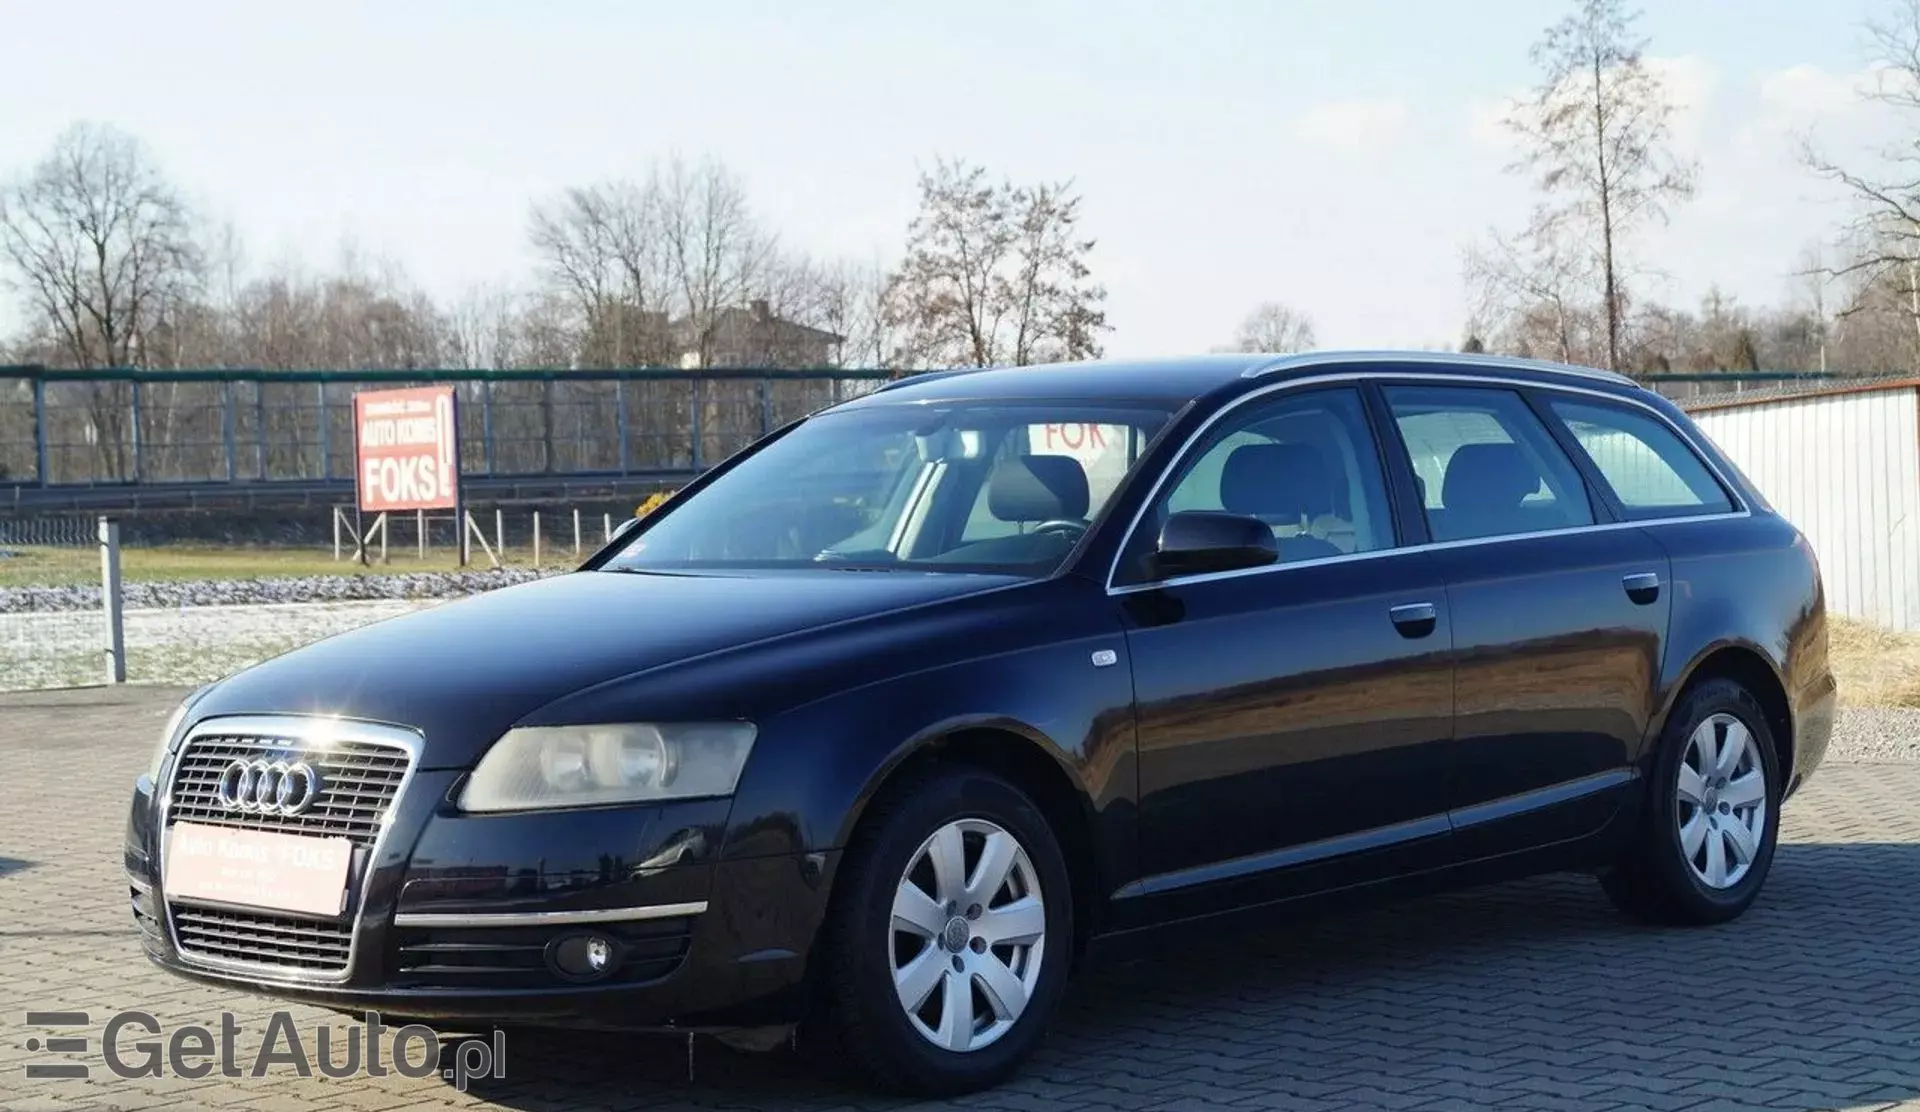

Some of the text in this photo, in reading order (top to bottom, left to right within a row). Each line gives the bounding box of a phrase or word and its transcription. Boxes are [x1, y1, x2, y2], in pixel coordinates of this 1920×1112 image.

[362, 419, 396, 448] AUTO
[365, 455, 437, 504] FOKS
[178, 833, 211, 857] Auto
